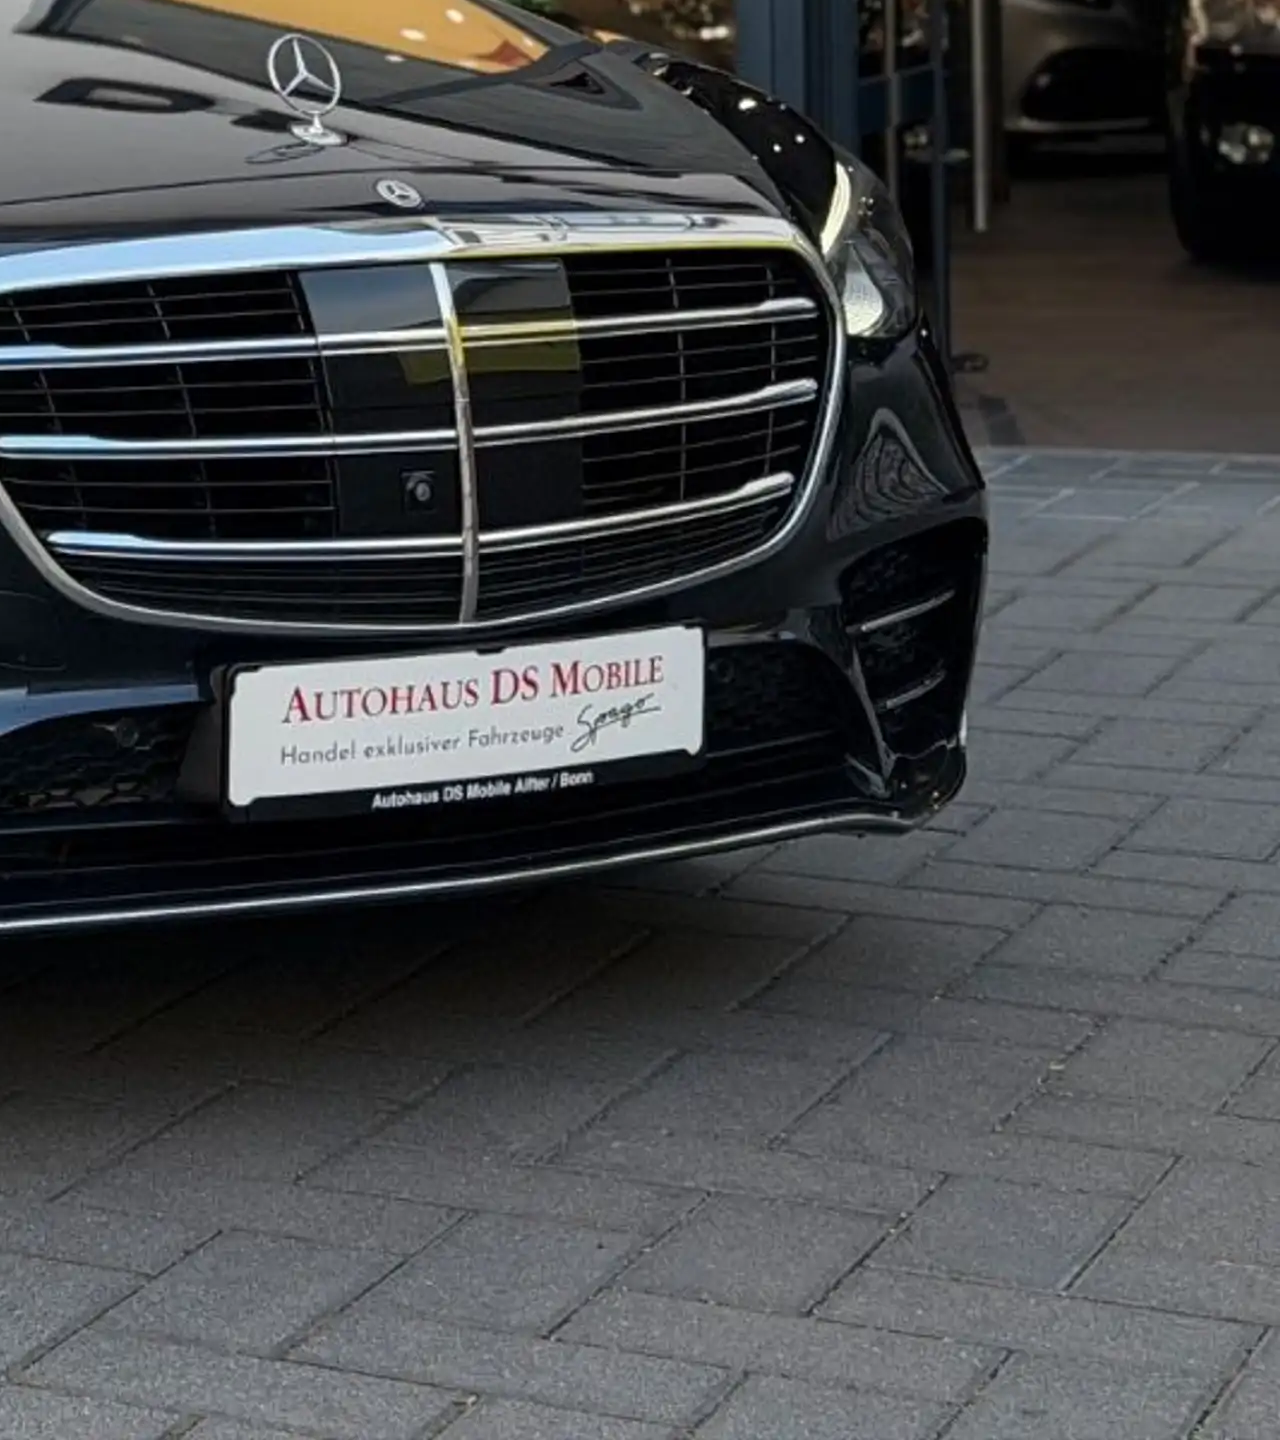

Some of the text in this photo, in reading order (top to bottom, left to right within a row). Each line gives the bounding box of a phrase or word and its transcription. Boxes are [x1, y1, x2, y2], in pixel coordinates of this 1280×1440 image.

[281, 655, 664, 723] AUTOHAUS DS MOBILE
[280, 725, 564, 765] Handel exklusiver Fahrzeuge
[371, 786, 440, 809] Autohaus
[442, 784, 464, 802] DS
[466, 779, 513, 800] Mobile
[559, 770, 595, 789] Bonn
